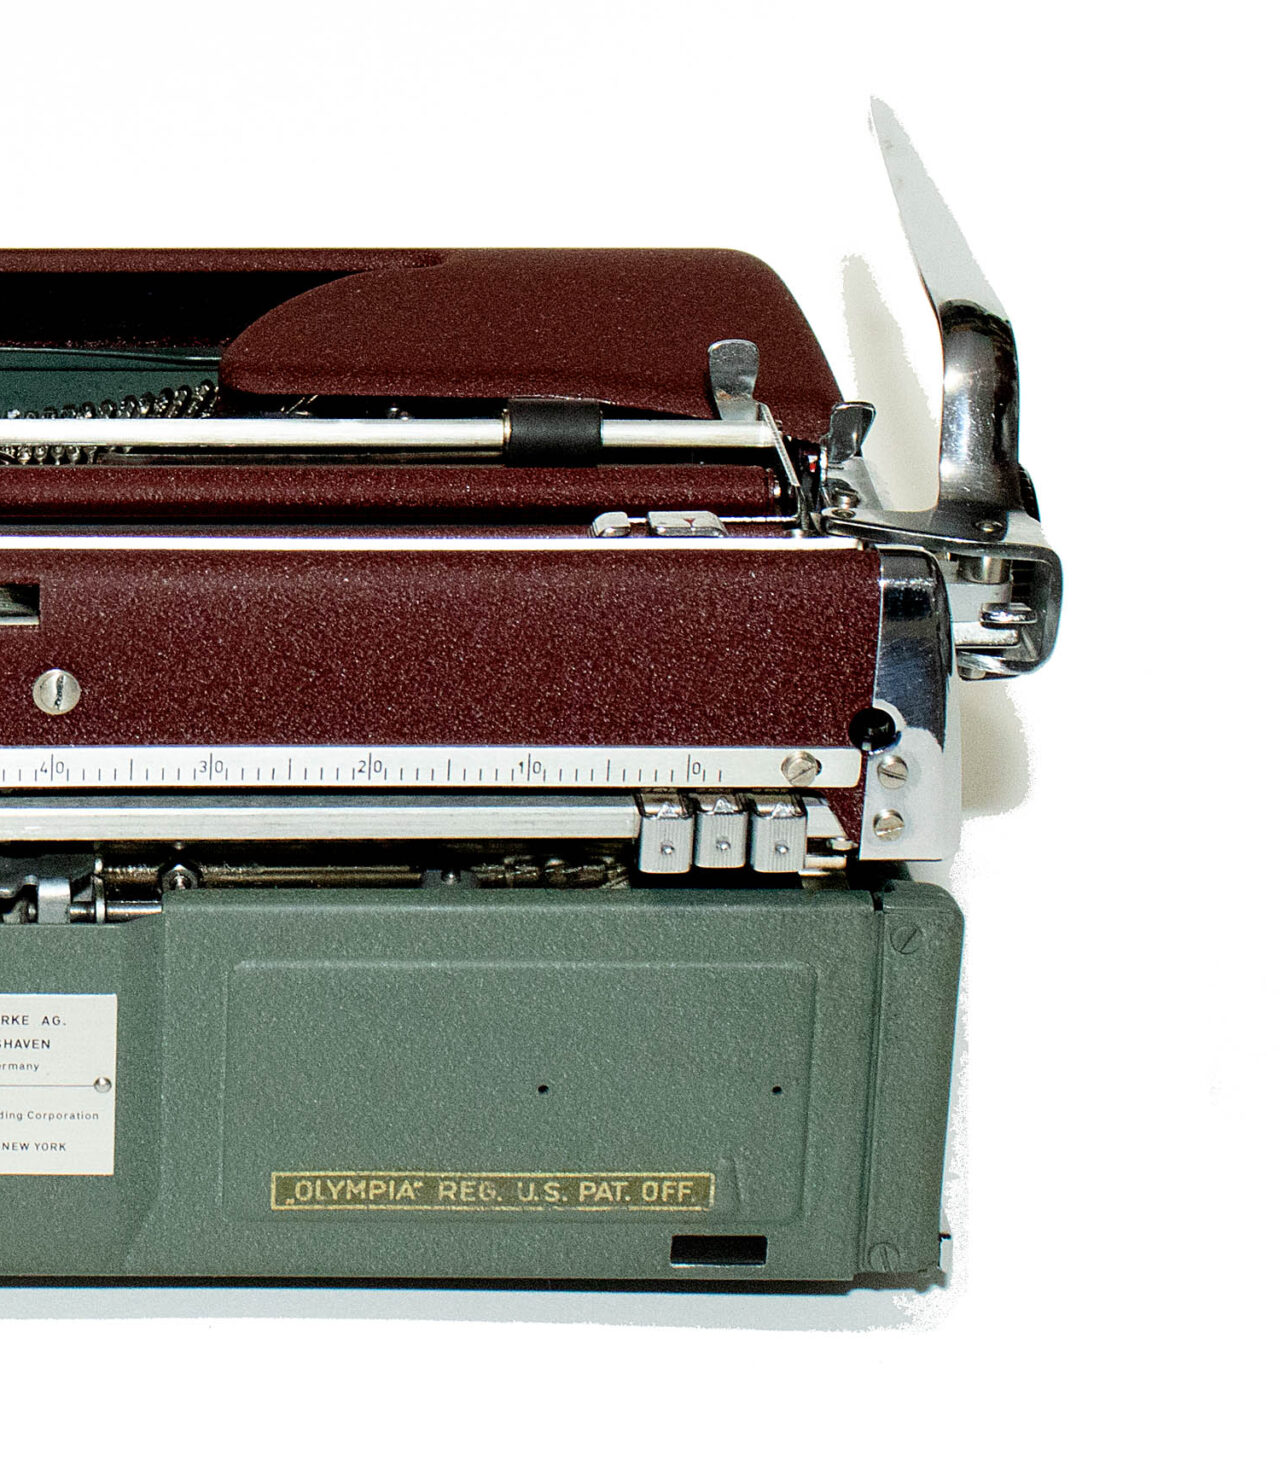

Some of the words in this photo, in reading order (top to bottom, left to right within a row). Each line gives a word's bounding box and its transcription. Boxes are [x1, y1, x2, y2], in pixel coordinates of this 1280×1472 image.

[40, 761, 65, 774] 40
[199, 760, 224, 773] 30
[357, 760, 382, 773] 20
[518, 760, 542, 774] 10
[41, 1015, 67, 1026] AG.
[26, 1110, 99, 1122] Corporation
[2, 1141, 30, 1151] NEW
[34, 1141, 67, 1151] YORK
[438, 1180, 503, 1202] REG.
[517, 1180, 568, 1202] U.S.
[579, 1181, 632, 1202] PAT.
